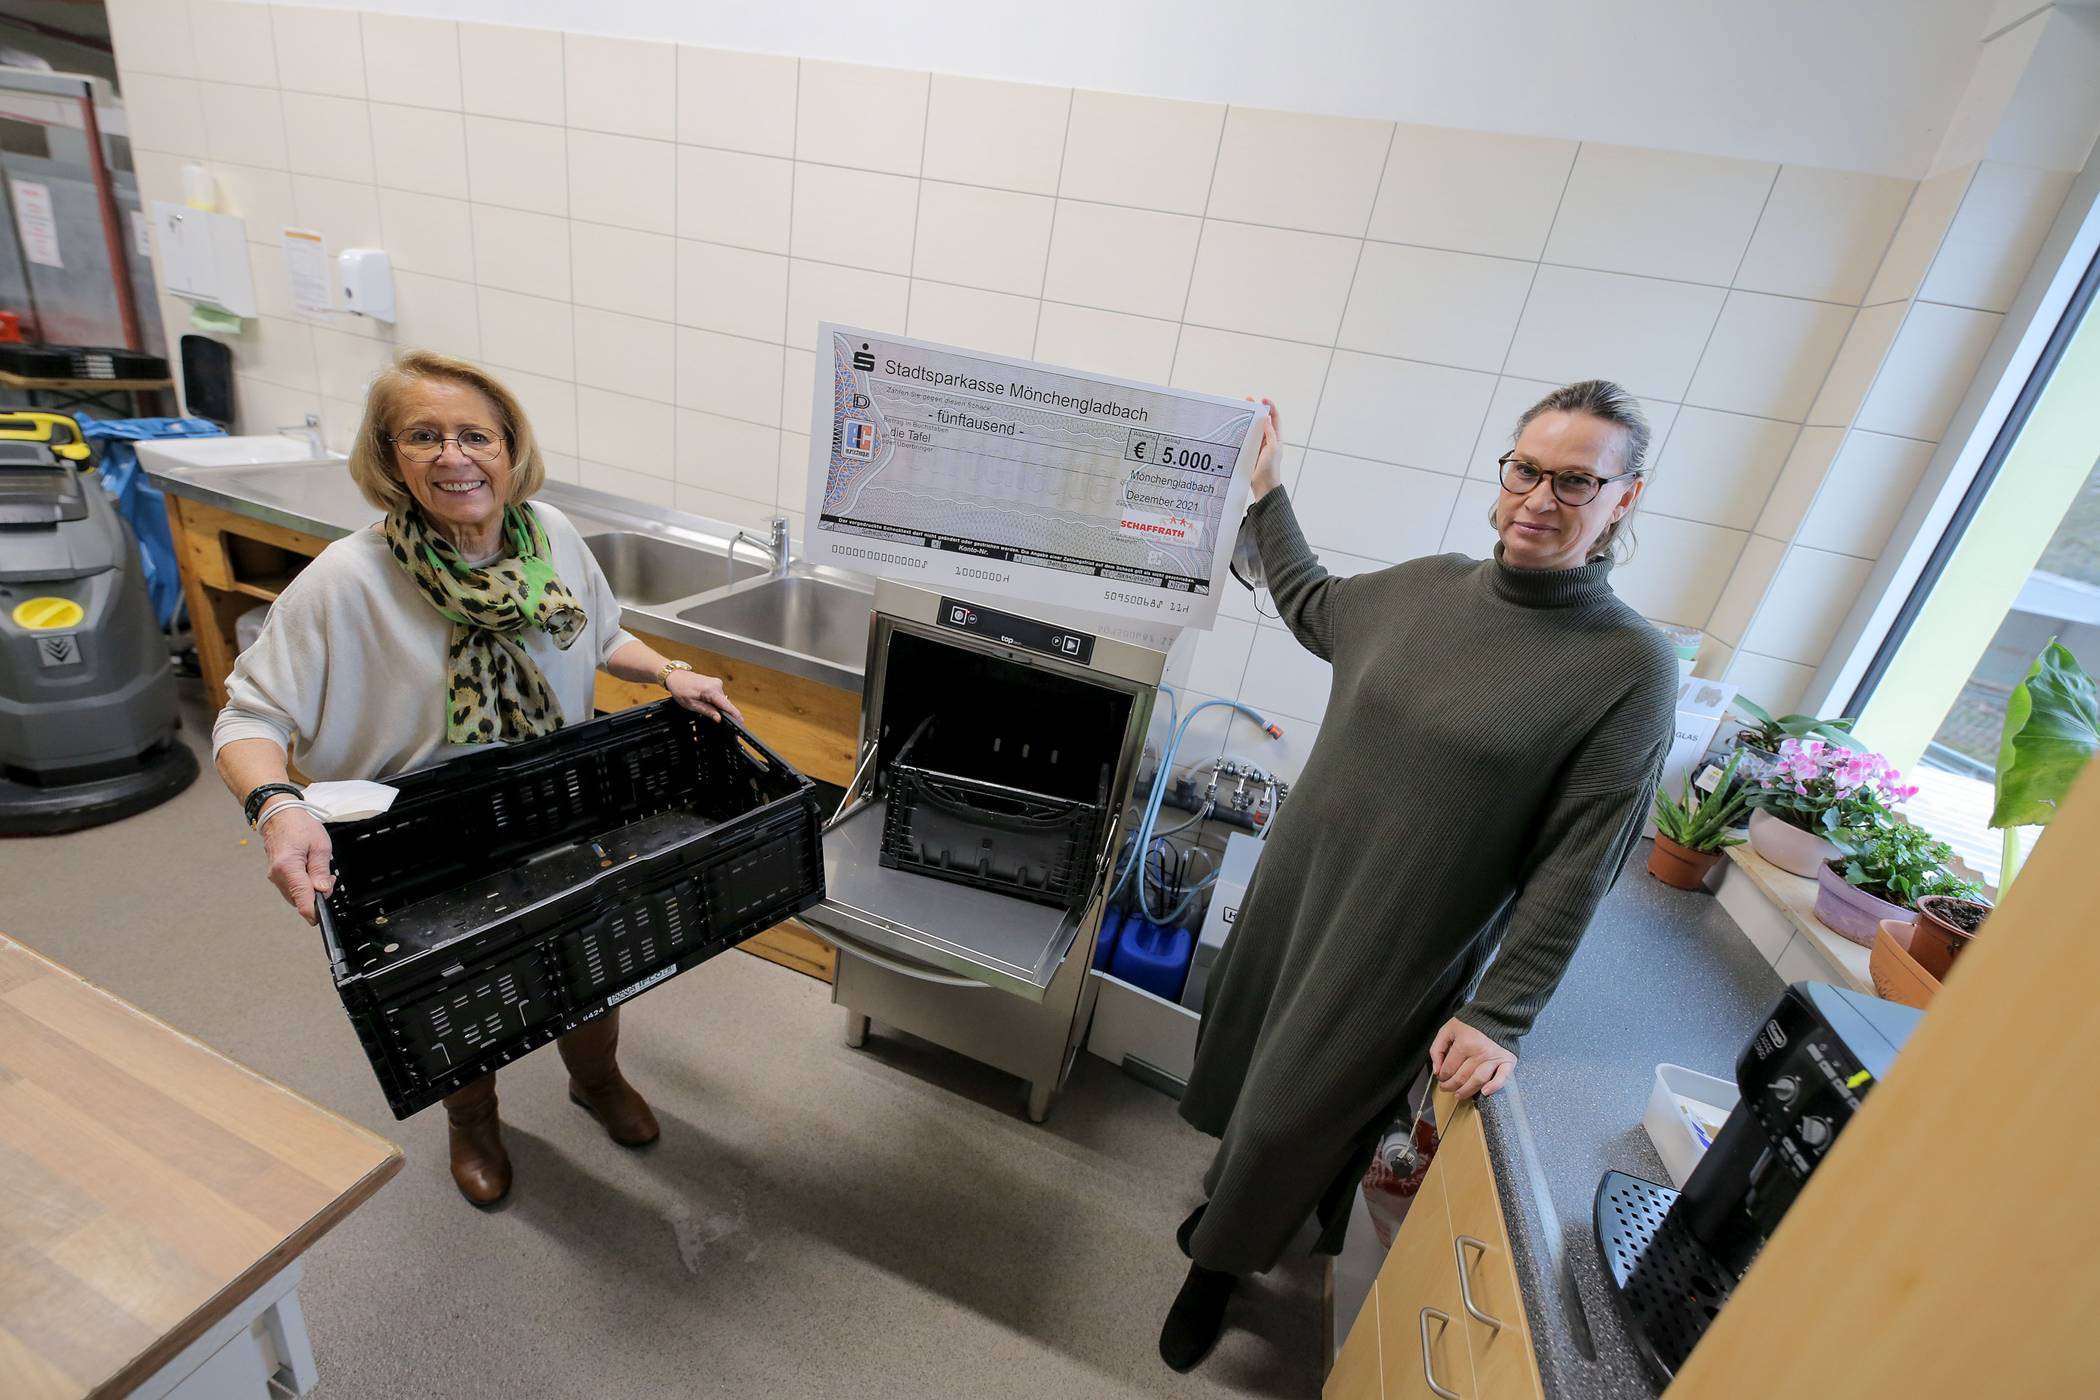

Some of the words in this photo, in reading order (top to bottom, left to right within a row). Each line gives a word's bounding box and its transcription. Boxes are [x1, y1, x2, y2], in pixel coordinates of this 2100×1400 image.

[885, 359, 1004, 394] Stadtsparkasse
[1010, 383, 1148, 422] Mönchengladbach
[853, 393, 870, 409] D
[937, 409, 1015, 435] fünftausend
[890, 428, 904, 439] die
[908, 430, 931, 443] Tafel
[1134, 441, 1147, 459] €
[1162, 446, 1223, 472] 5.000.-
[1126, 490, 1173, 508] Dezember
[1176, 500, 1199, 512] 2021
[1121, 520, 1185, 538] SCHAFFRATH
[958, 545, 989, 556] Konto-Nr.
[1001, 635, 1014, 645] top
[1675, 731, 1699, 741] GLAS
